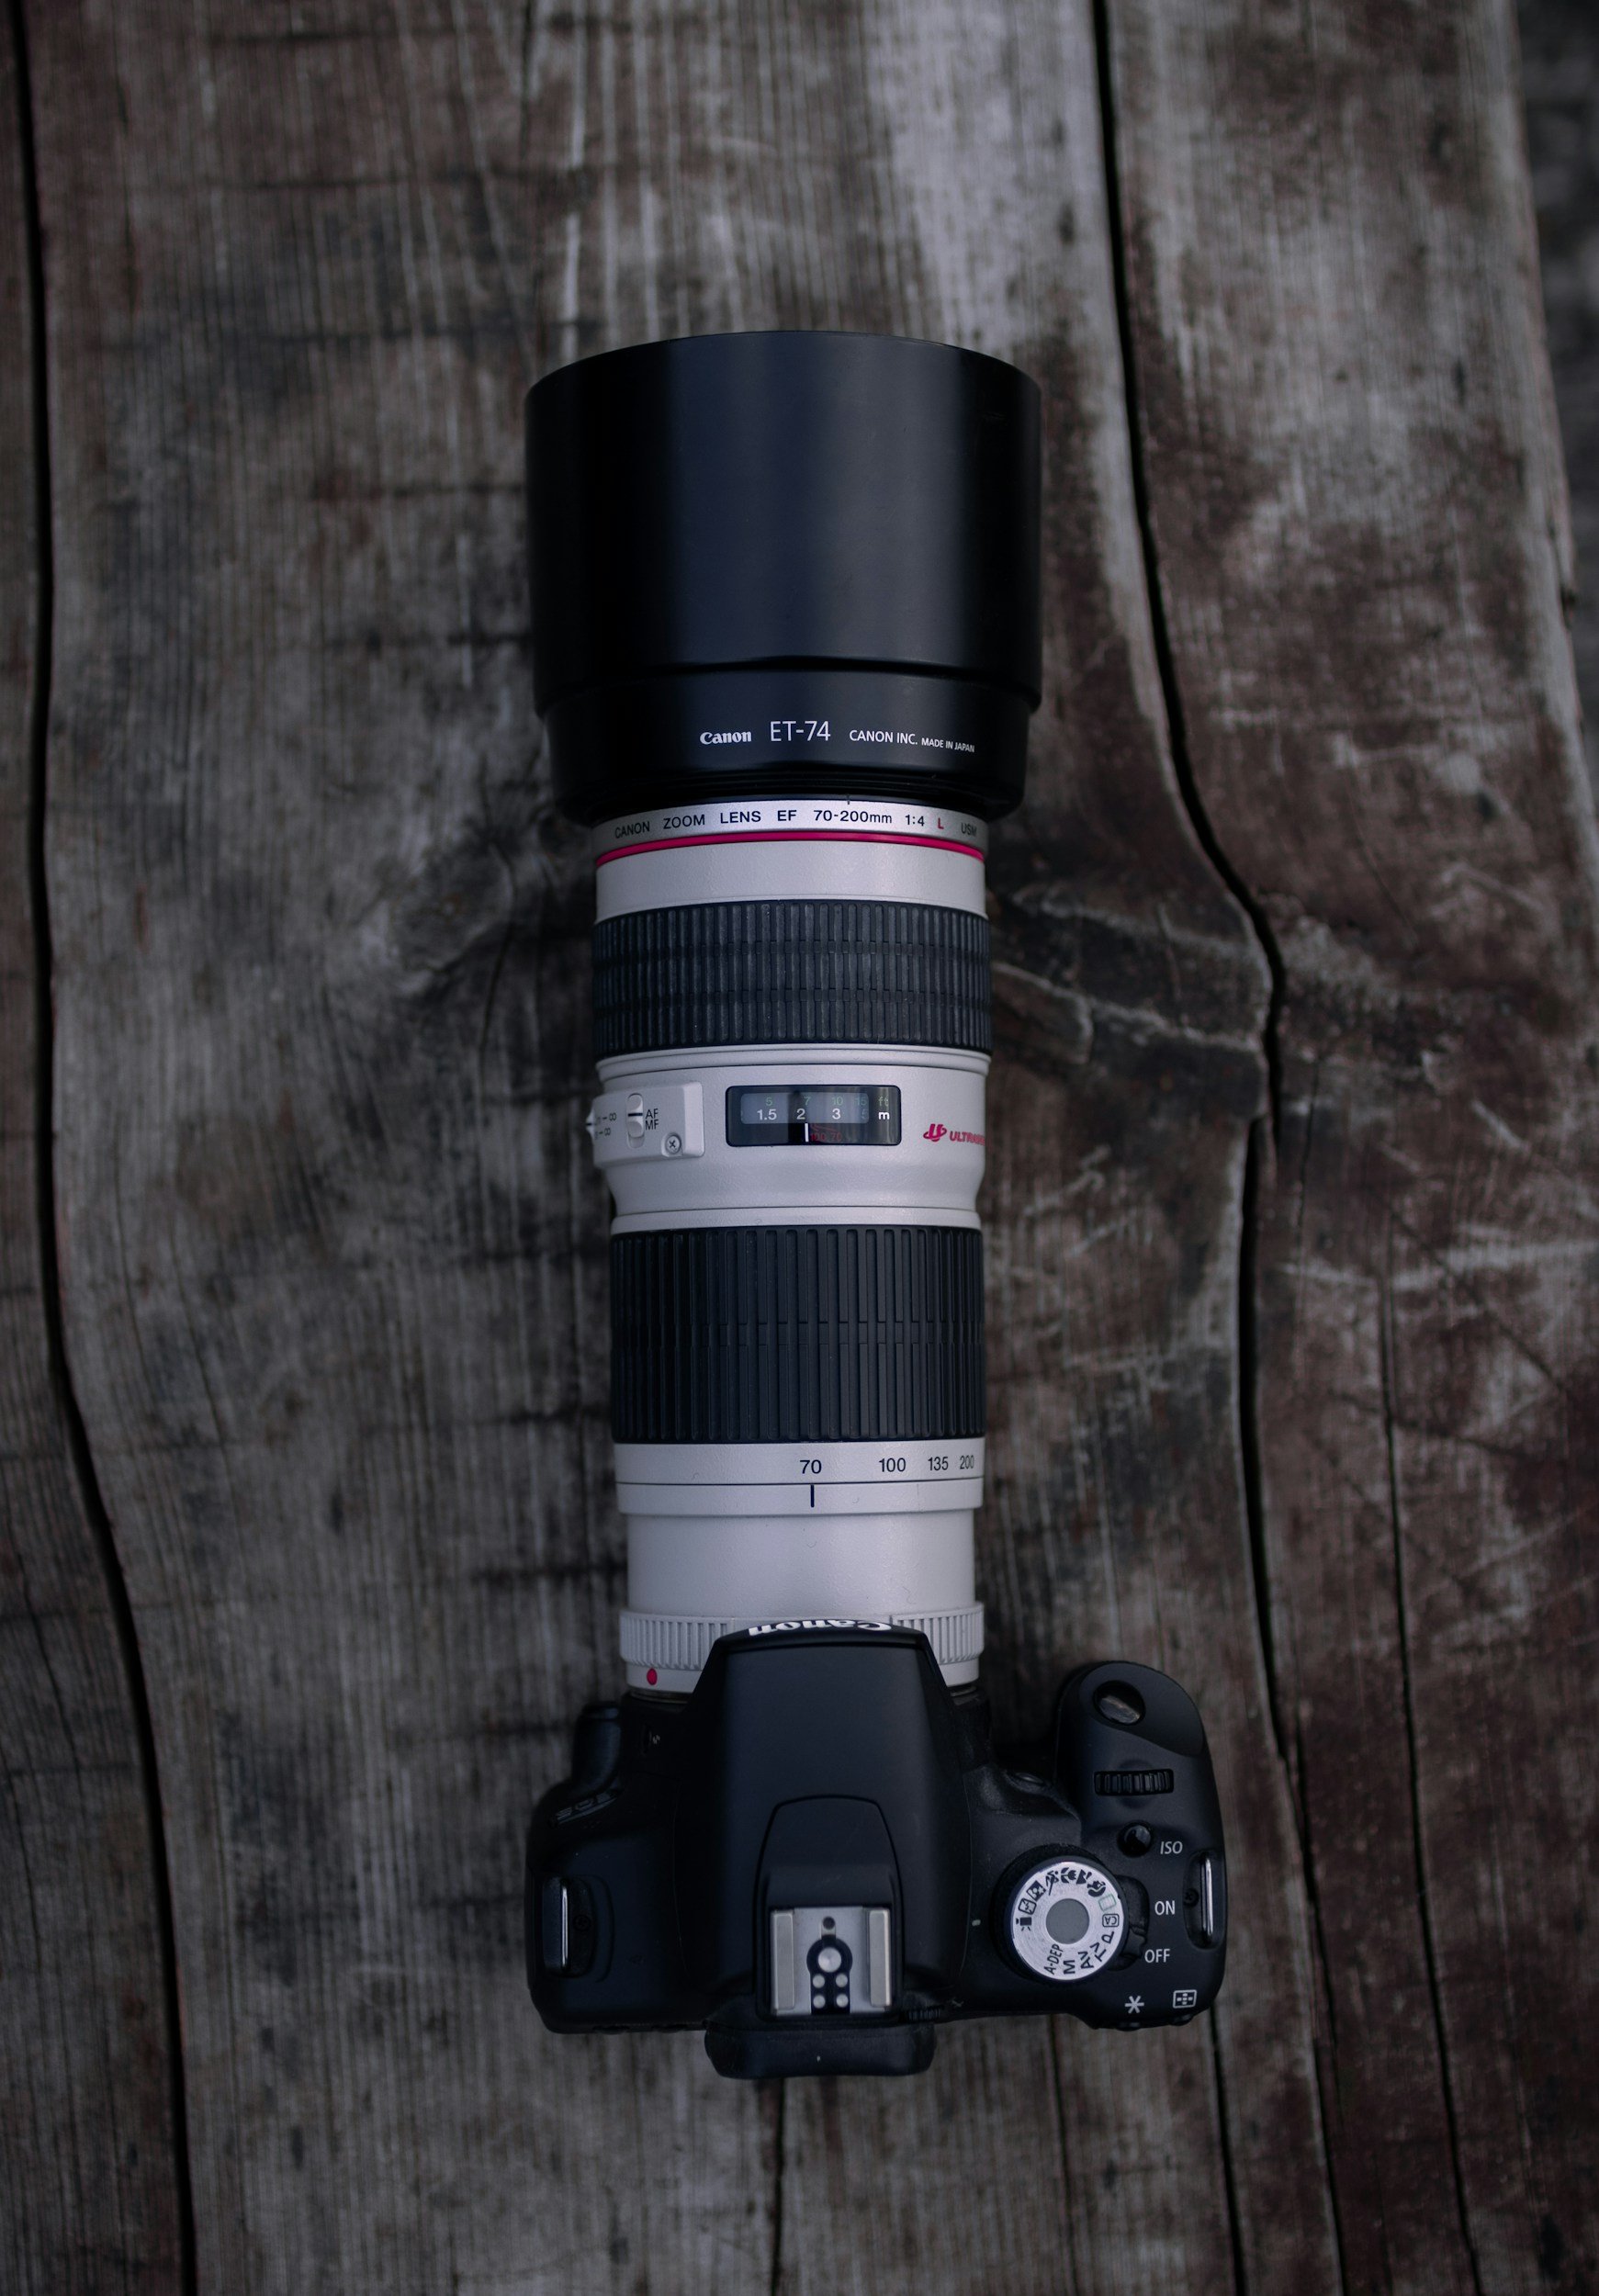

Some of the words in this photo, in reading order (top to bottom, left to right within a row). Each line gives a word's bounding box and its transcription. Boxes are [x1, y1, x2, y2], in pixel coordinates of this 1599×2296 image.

[700, 731, 751, 745] Canon
[770, 721, 830, 741] ET-74
[849, 729, 894, 743] CANON
[896, 732, 918, 745] INC.
[921, 737, 943, 748] MADE
[945, 740, 953, 749] IN
[954, 741, 974, 752] JAPAN
[614, 821, 650, 838] CANON
[663, 814, 705, 829] ZOOM
[720, 811, 761, 824] LENS
[777, 810, 797, 822] EF
[813, 809, 893, 824] 70-200mm
[905, 814, 925, 827] 1:4
[938, 817, 944, 829] L
[961, 823, 977, 837] USM
[832, 1097, 843, 1106] 10
[645, 1108, 659, 1120] AF
[757, 1109, 777, 1120] 1.5
[796, 1109, 805, 1120] 2
[832, 1108, 841, 1120] 3
[878, 1111, 890, 1120] m
[645, 1119, 659, 1131] MF
[799, 1459, 822, 1474] 70
[878, 1458, 906, 1472] 100
[928, 1456, 949, 1470] 135
[960, 1455, 974, 1469] 200
[749, 1619, 892, 1637] Canon
[1160, 1840, 1183, 1854] ISO
[1154, 1900, 1176, 1915] ON
[1101, 1930, 1114, 1944] P
[1043, 1943, 1064, 1975] A-DEP
[1144, 1948, 1171, 1963] OFF
[1063, 1960, 1075, 1975] M
